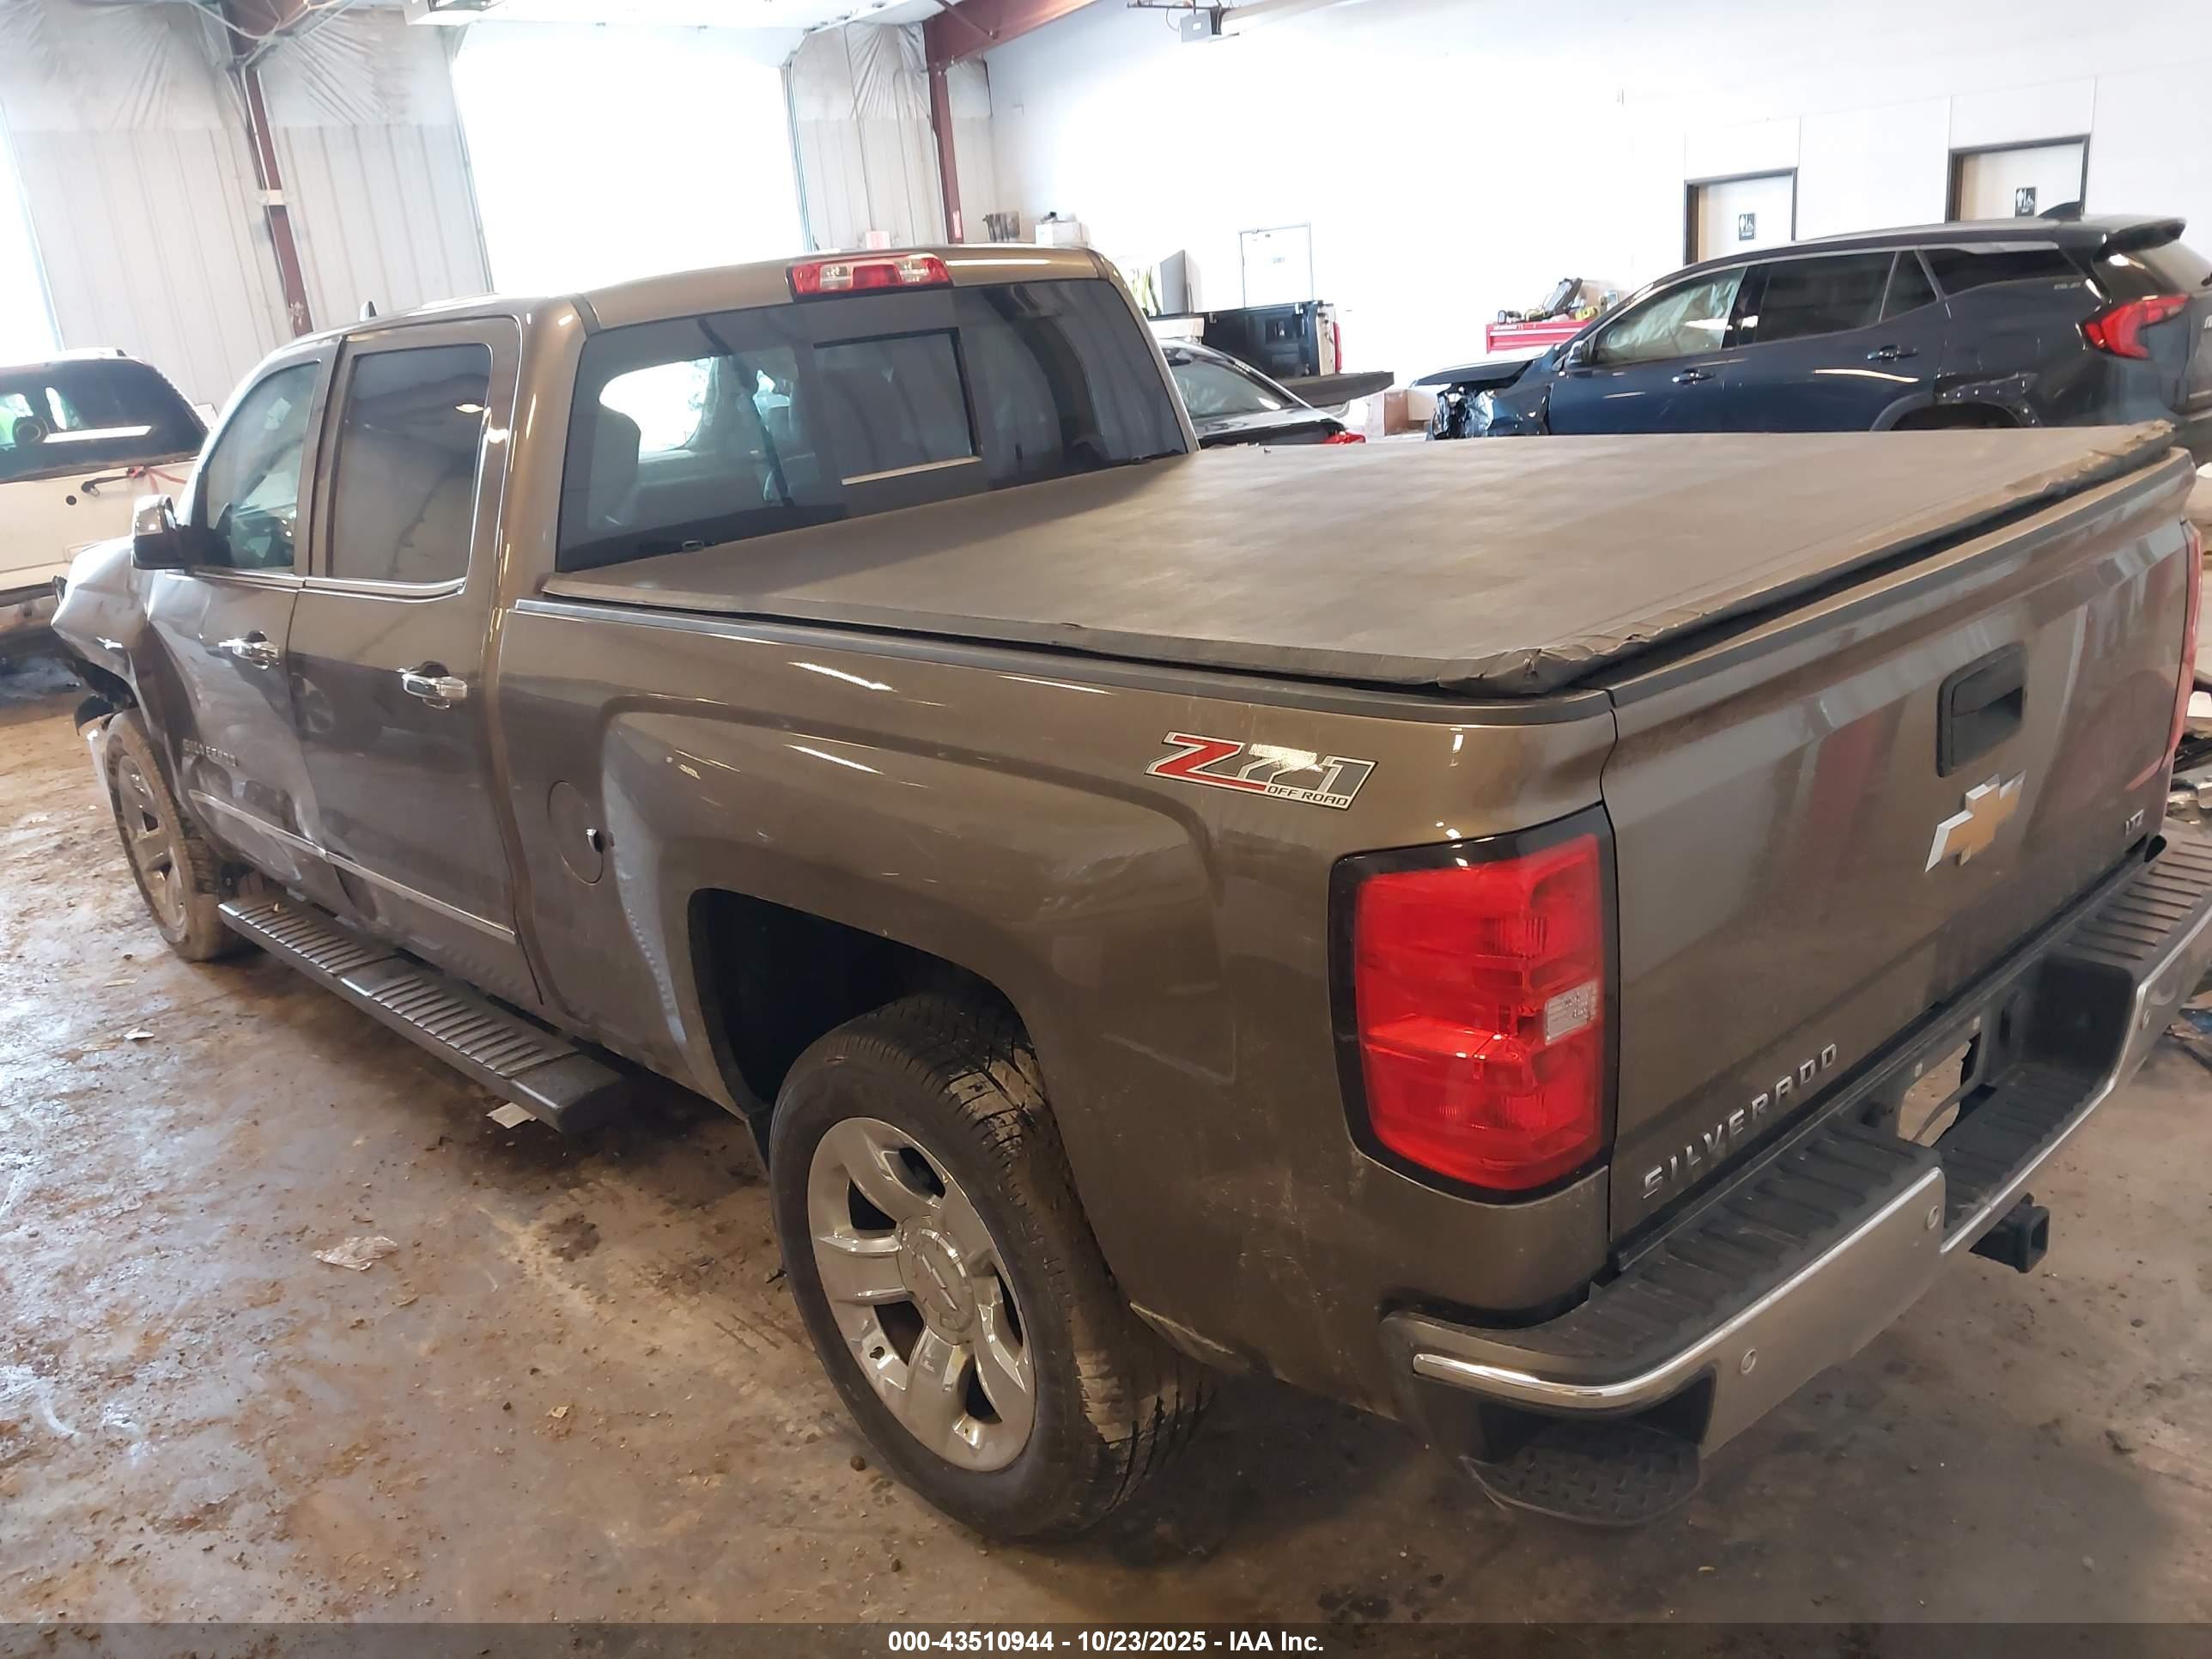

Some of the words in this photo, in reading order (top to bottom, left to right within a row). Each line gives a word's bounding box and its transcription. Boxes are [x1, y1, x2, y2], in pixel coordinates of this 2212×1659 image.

[1144, 731, 1378, 799] Z71
[1267, 785, 1298, 799] OFF
[1301, 792, 1349, 806] ROAD
[1642, 1043, 1838, 1200] SILVERADO
